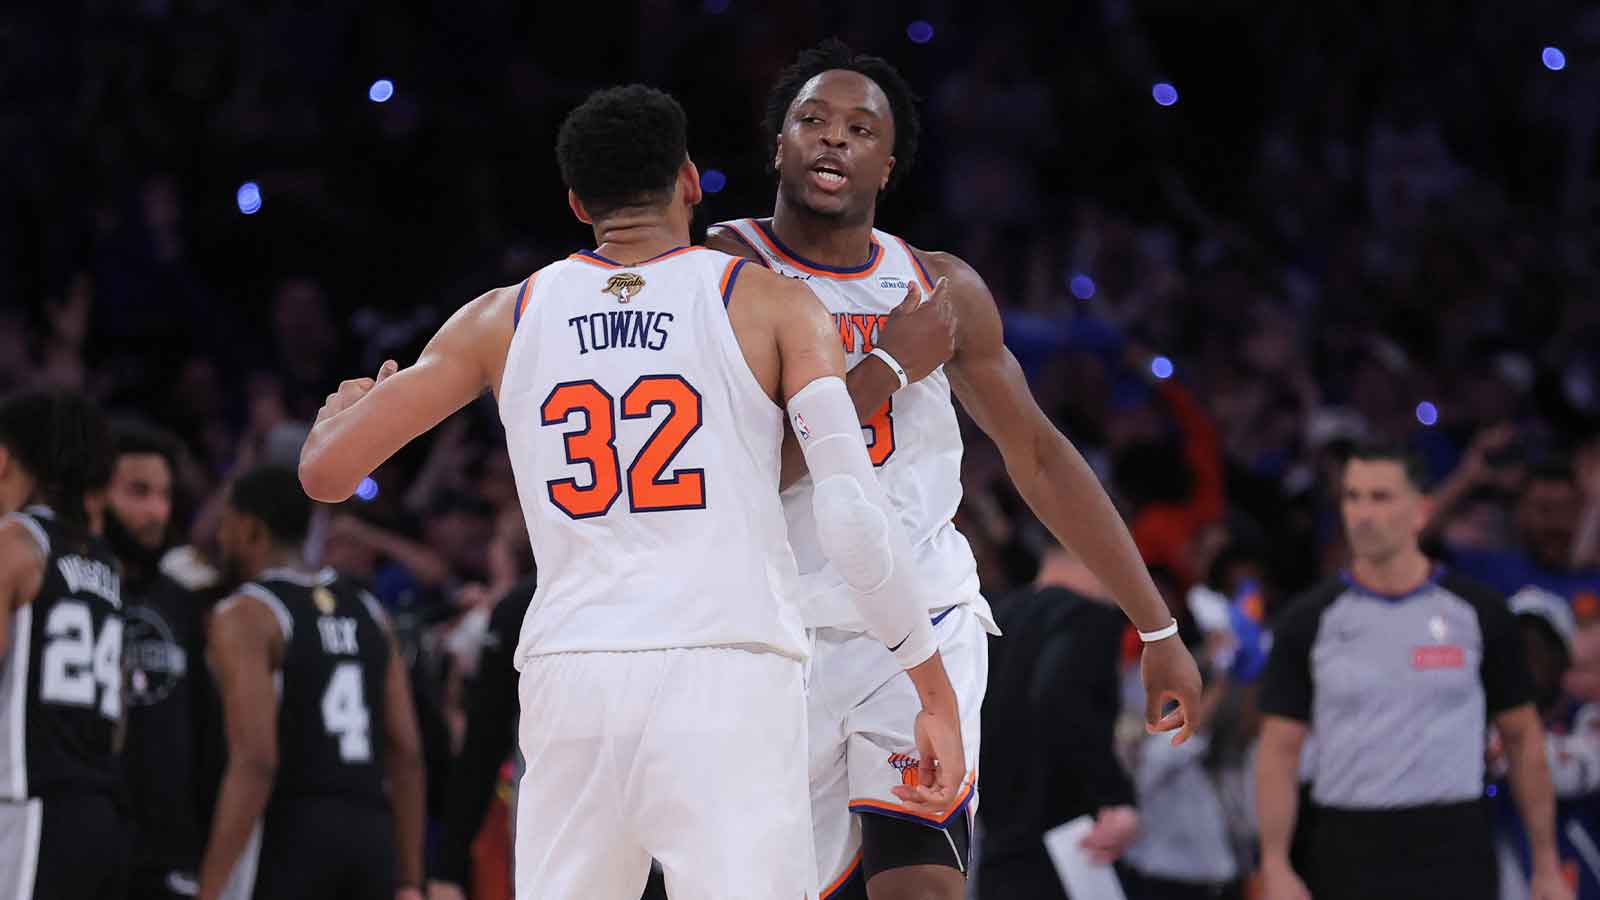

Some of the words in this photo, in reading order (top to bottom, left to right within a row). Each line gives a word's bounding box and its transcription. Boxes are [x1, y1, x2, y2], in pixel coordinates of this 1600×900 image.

[568, 310, 674, 355] TOWNS
[601, 275, 645, 292] Finals
[540, 374, 706, 520] 32
[42, 599, 124, 719] 24
[321, 661, 373, 763] 4
